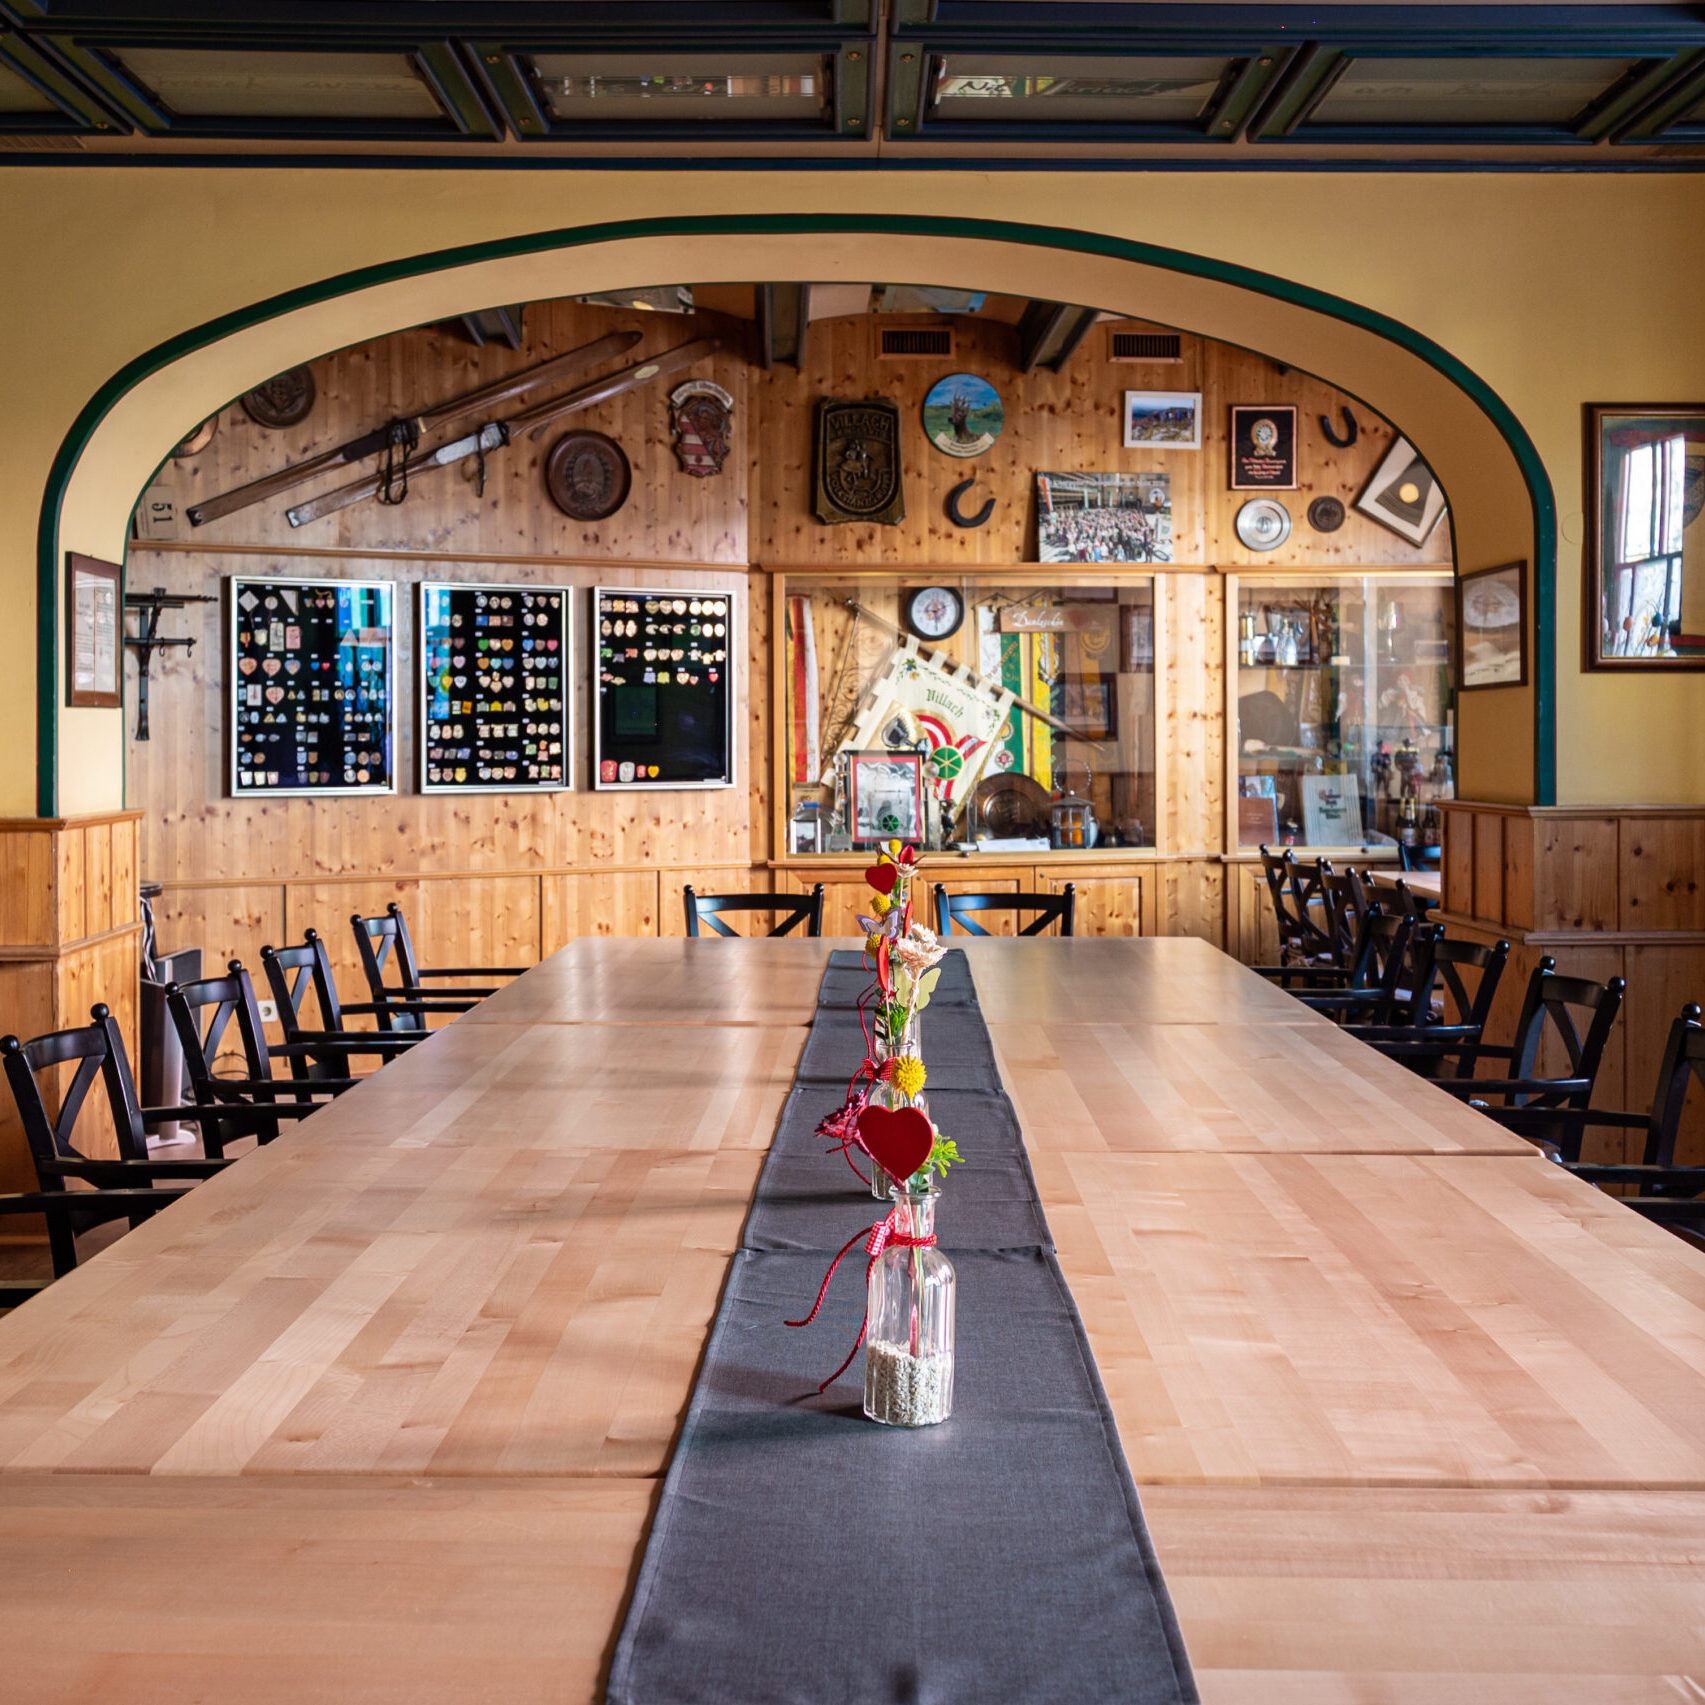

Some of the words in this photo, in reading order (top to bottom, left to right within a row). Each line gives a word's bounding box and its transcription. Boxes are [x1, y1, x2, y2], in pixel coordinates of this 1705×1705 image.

[831, 413, 889, 433] VILLACH
[152, 503, 173, 523] 51
[926, 688, 964, 718] Villach
